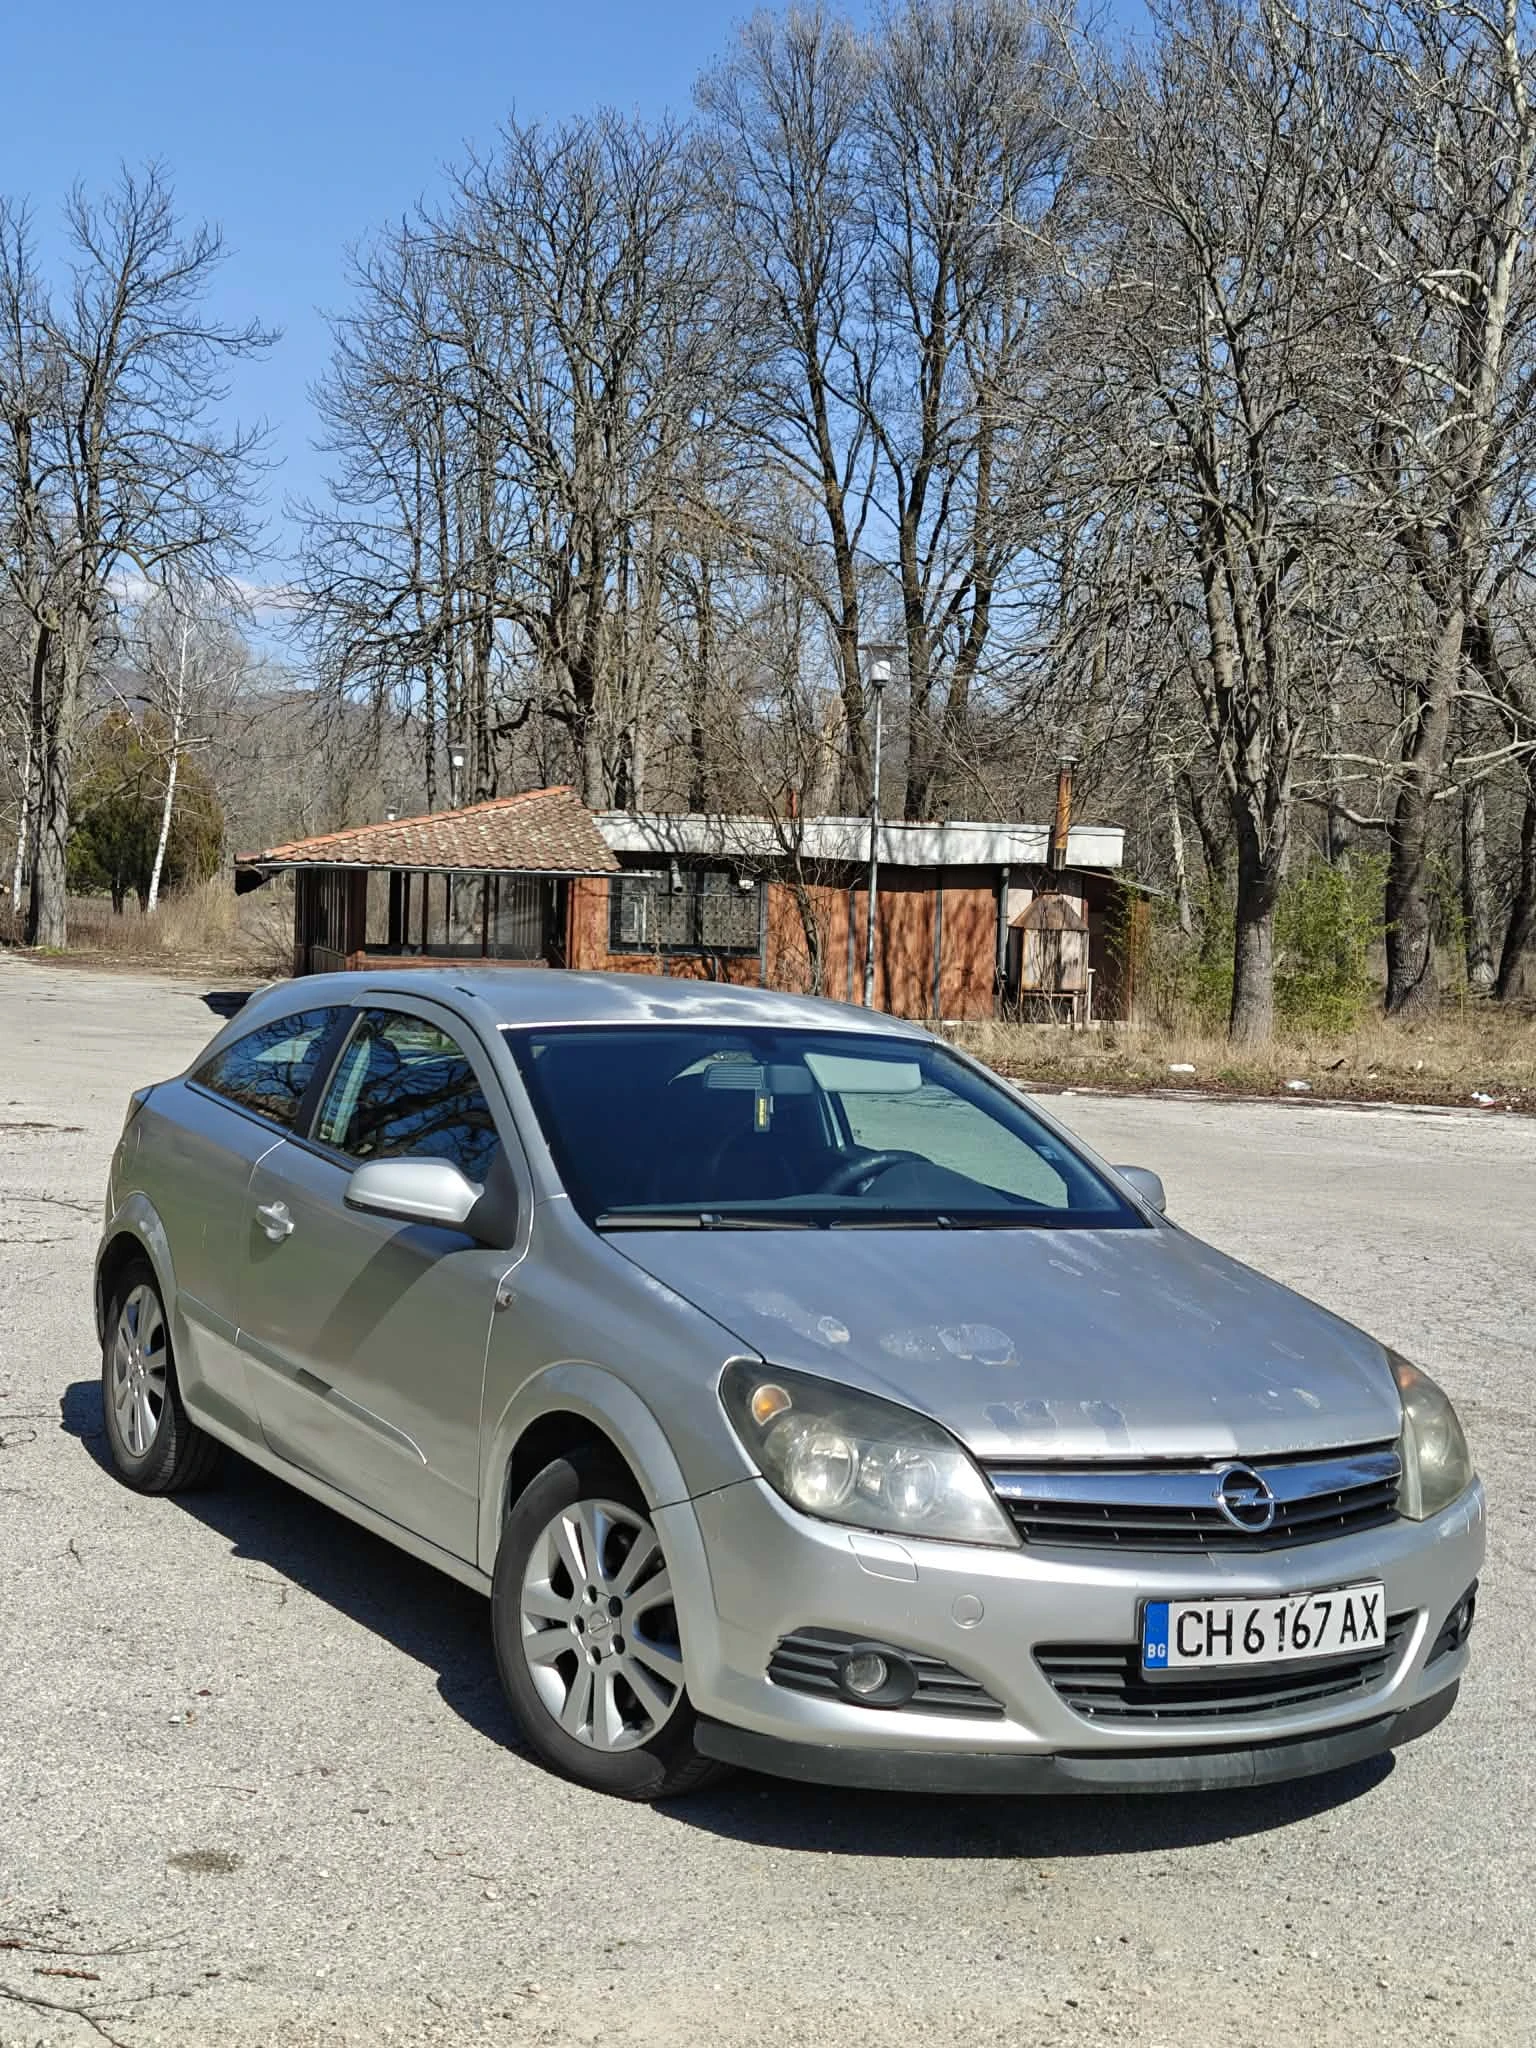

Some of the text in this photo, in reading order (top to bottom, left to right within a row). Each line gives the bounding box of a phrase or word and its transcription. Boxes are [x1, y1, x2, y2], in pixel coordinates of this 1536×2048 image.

[1176, 1593, 1379, 1657] CH 6167 AX
[1147, 1643, 1167, 1659] BG
